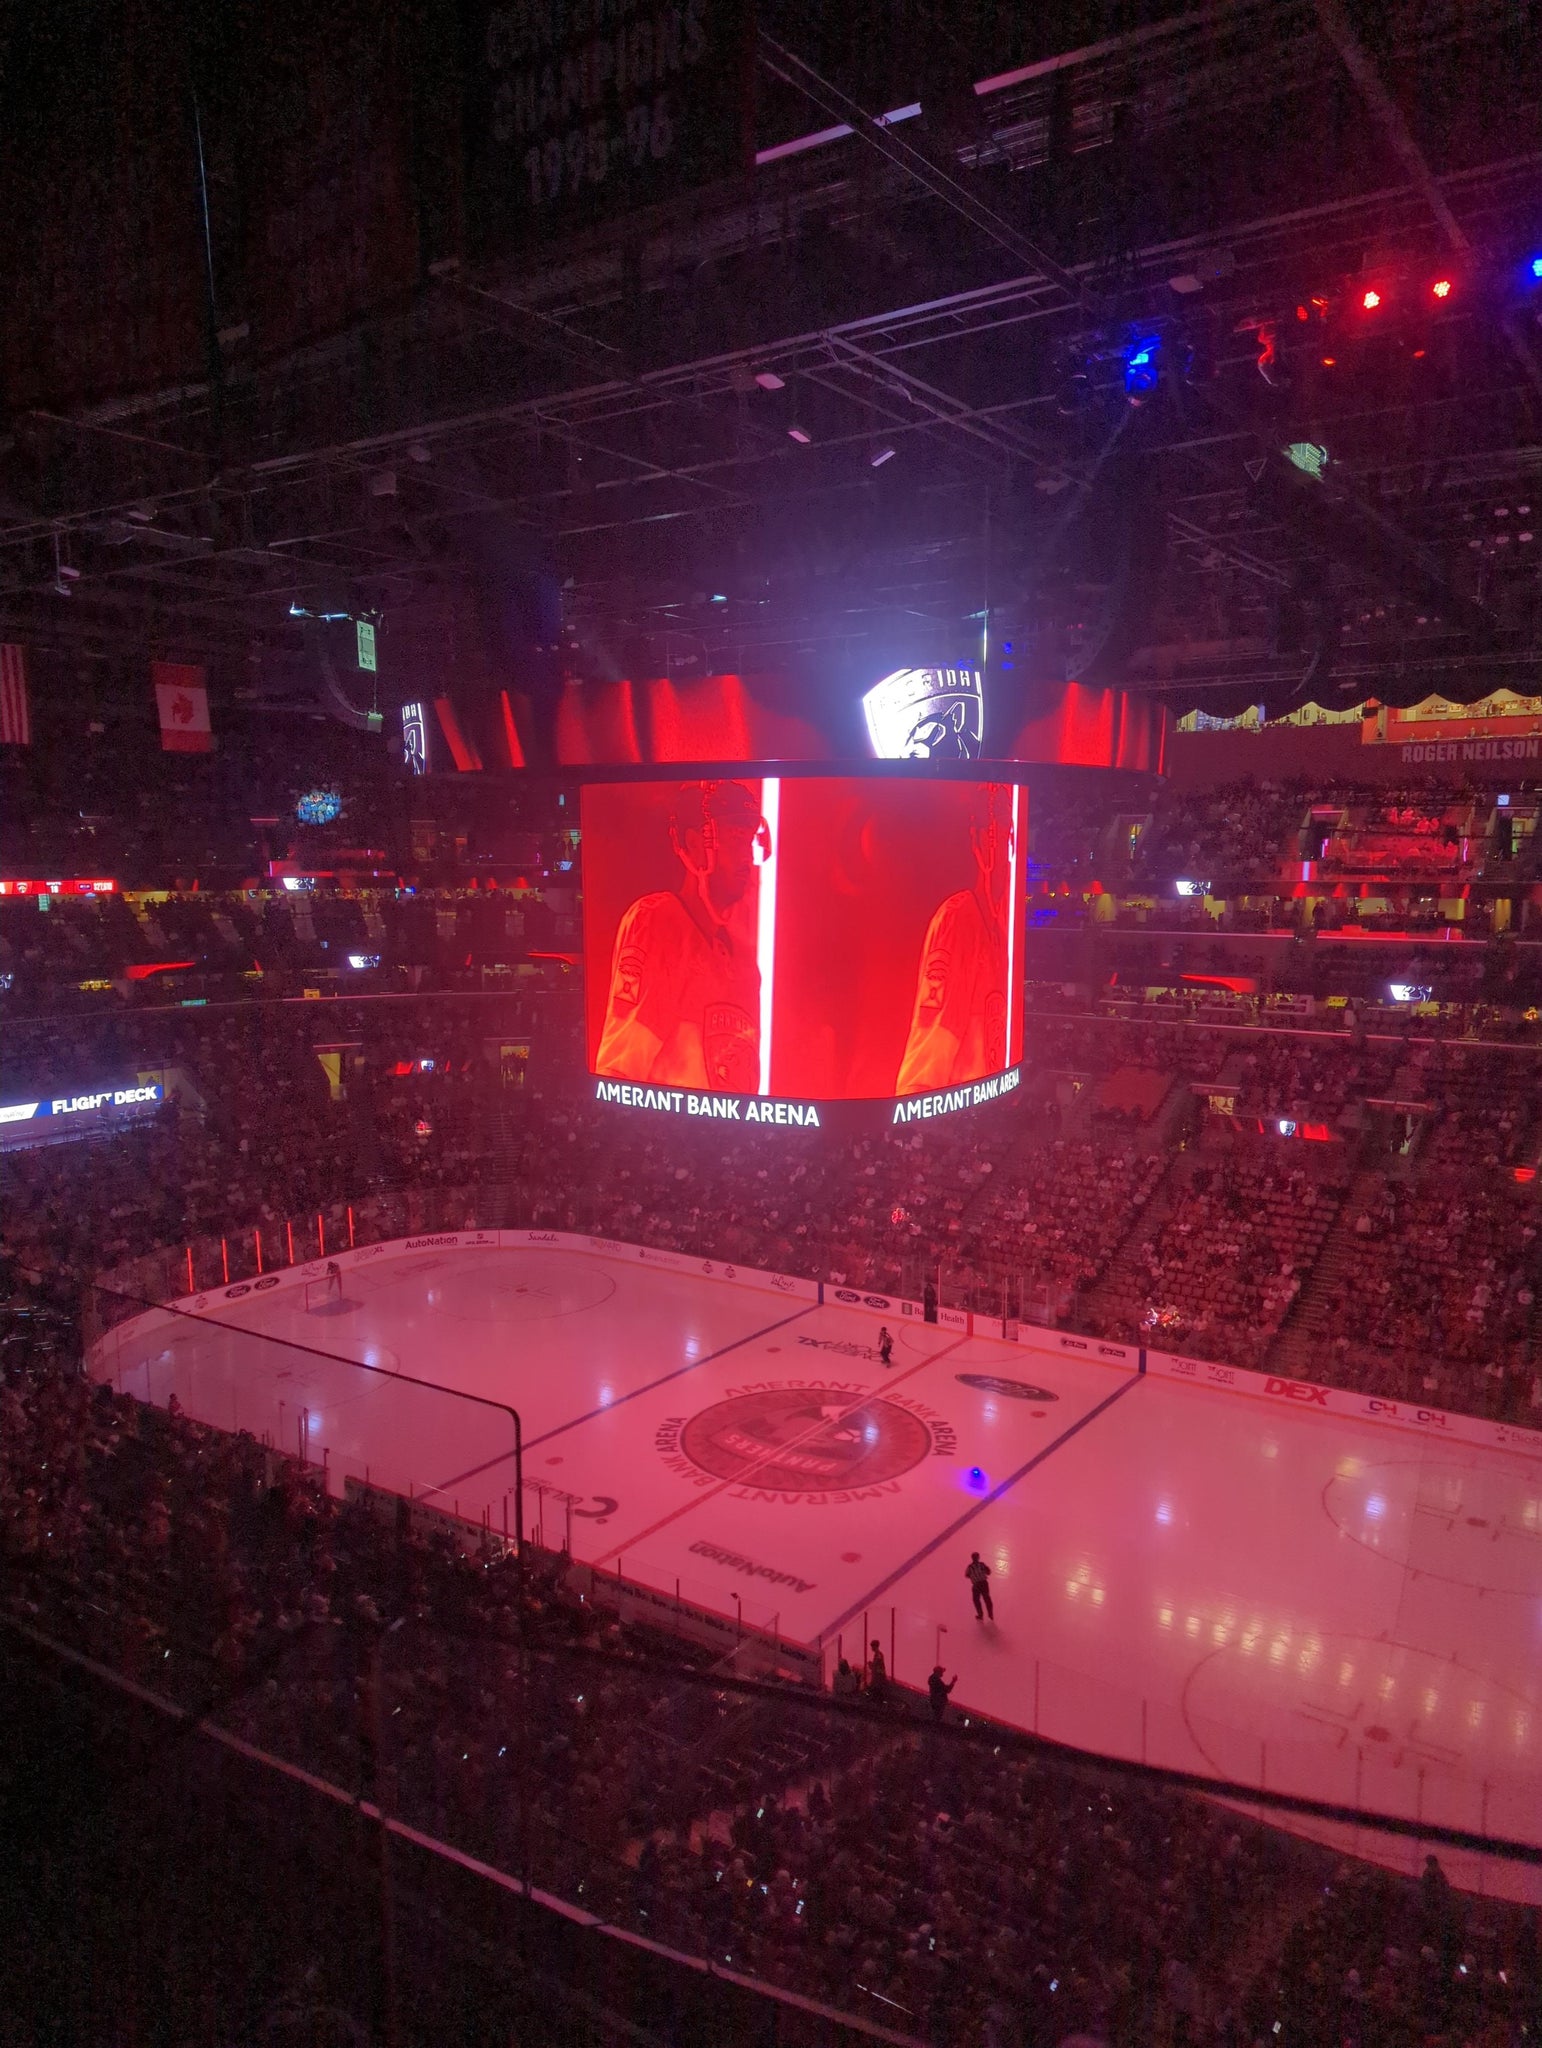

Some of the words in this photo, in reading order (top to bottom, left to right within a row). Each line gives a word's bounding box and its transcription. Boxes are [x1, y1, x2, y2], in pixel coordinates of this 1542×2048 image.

[523, 93, 673, 204] 1995-96
[1402, 744, 1457, 763] ROGER
[1462, 739, 1540, 760] NEILSON
[51, 1092, 113, 1115] FLIGHT
[114, 1086, 157, 1105] DECK
[596, 1081, 684, 1113] AMERANT
[687, 1096, 741, 1120] BANK
[745, 1101, 820, 1127] ARENA
[893, 1088, 972, 1124] AMERANT
[973, 1077, 999, 1105] BANK
[999, 1068, 1019, 1094] ARENA
[405, 1235, 458, 1250] AutoNation
[840, 1290, 858, 1301] Ford
[867, 1298, 887, 1308] Ford
[940, 1312, 965, 1325] Health
[1264, 1377, 1331, 1405] DEX
[724, 1379, 871, 1398] AMERANT
[884, 1391, 940, 1420] BANK
[927, 1420, 957, 1457] ARENA
[655, 1416, 688, 1452] ARENA
[661, 1455, 717, 1488] BANK
[728, 1480, 903, 1506] AMERANT
[689, 1542, 818, 1593] AutoNation
